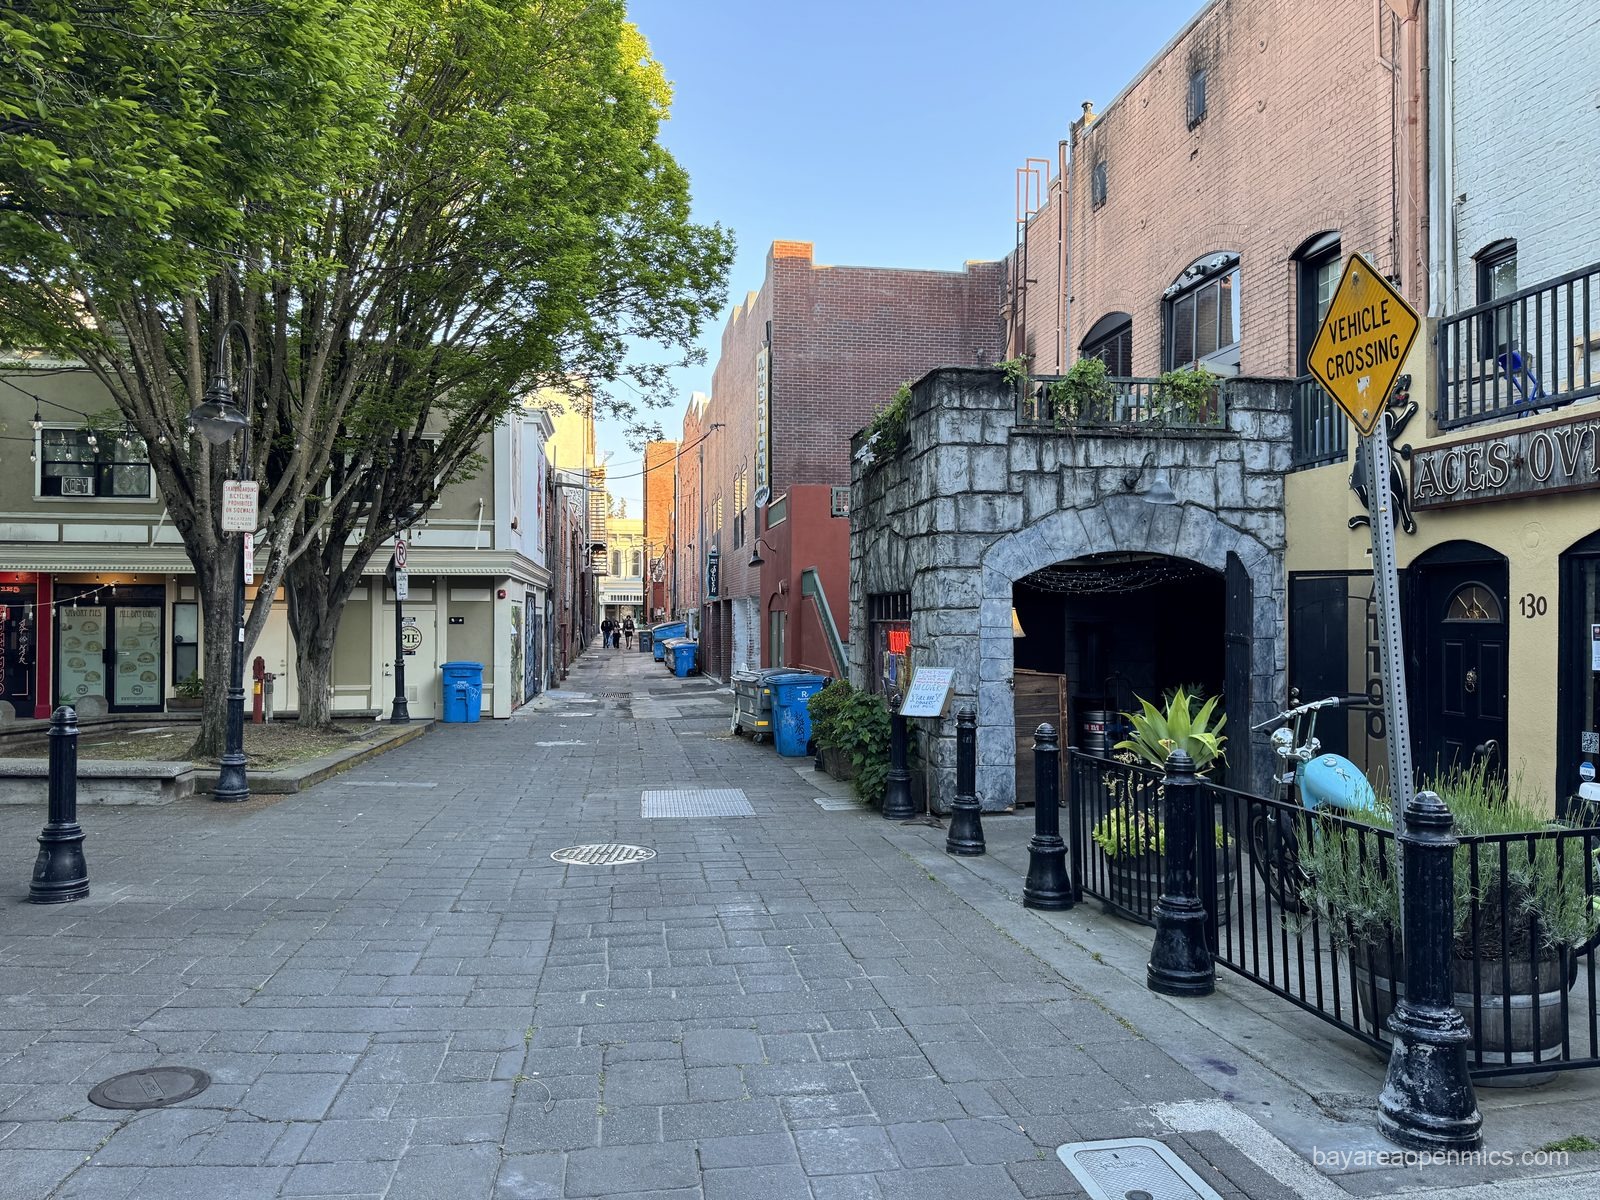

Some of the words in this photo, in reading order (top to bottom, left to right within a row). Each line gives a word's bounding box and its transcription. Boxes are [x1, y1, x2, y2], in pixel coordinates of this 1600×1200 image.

[1328, 298, 1391, 345] VEHICLE
[1326, 333, 1400, 381] CROSSING
[1413, 441, 1510, 499] ACES
[1518, 592, 1548, 619] 130
[402, 634, 419, 643] PIE
